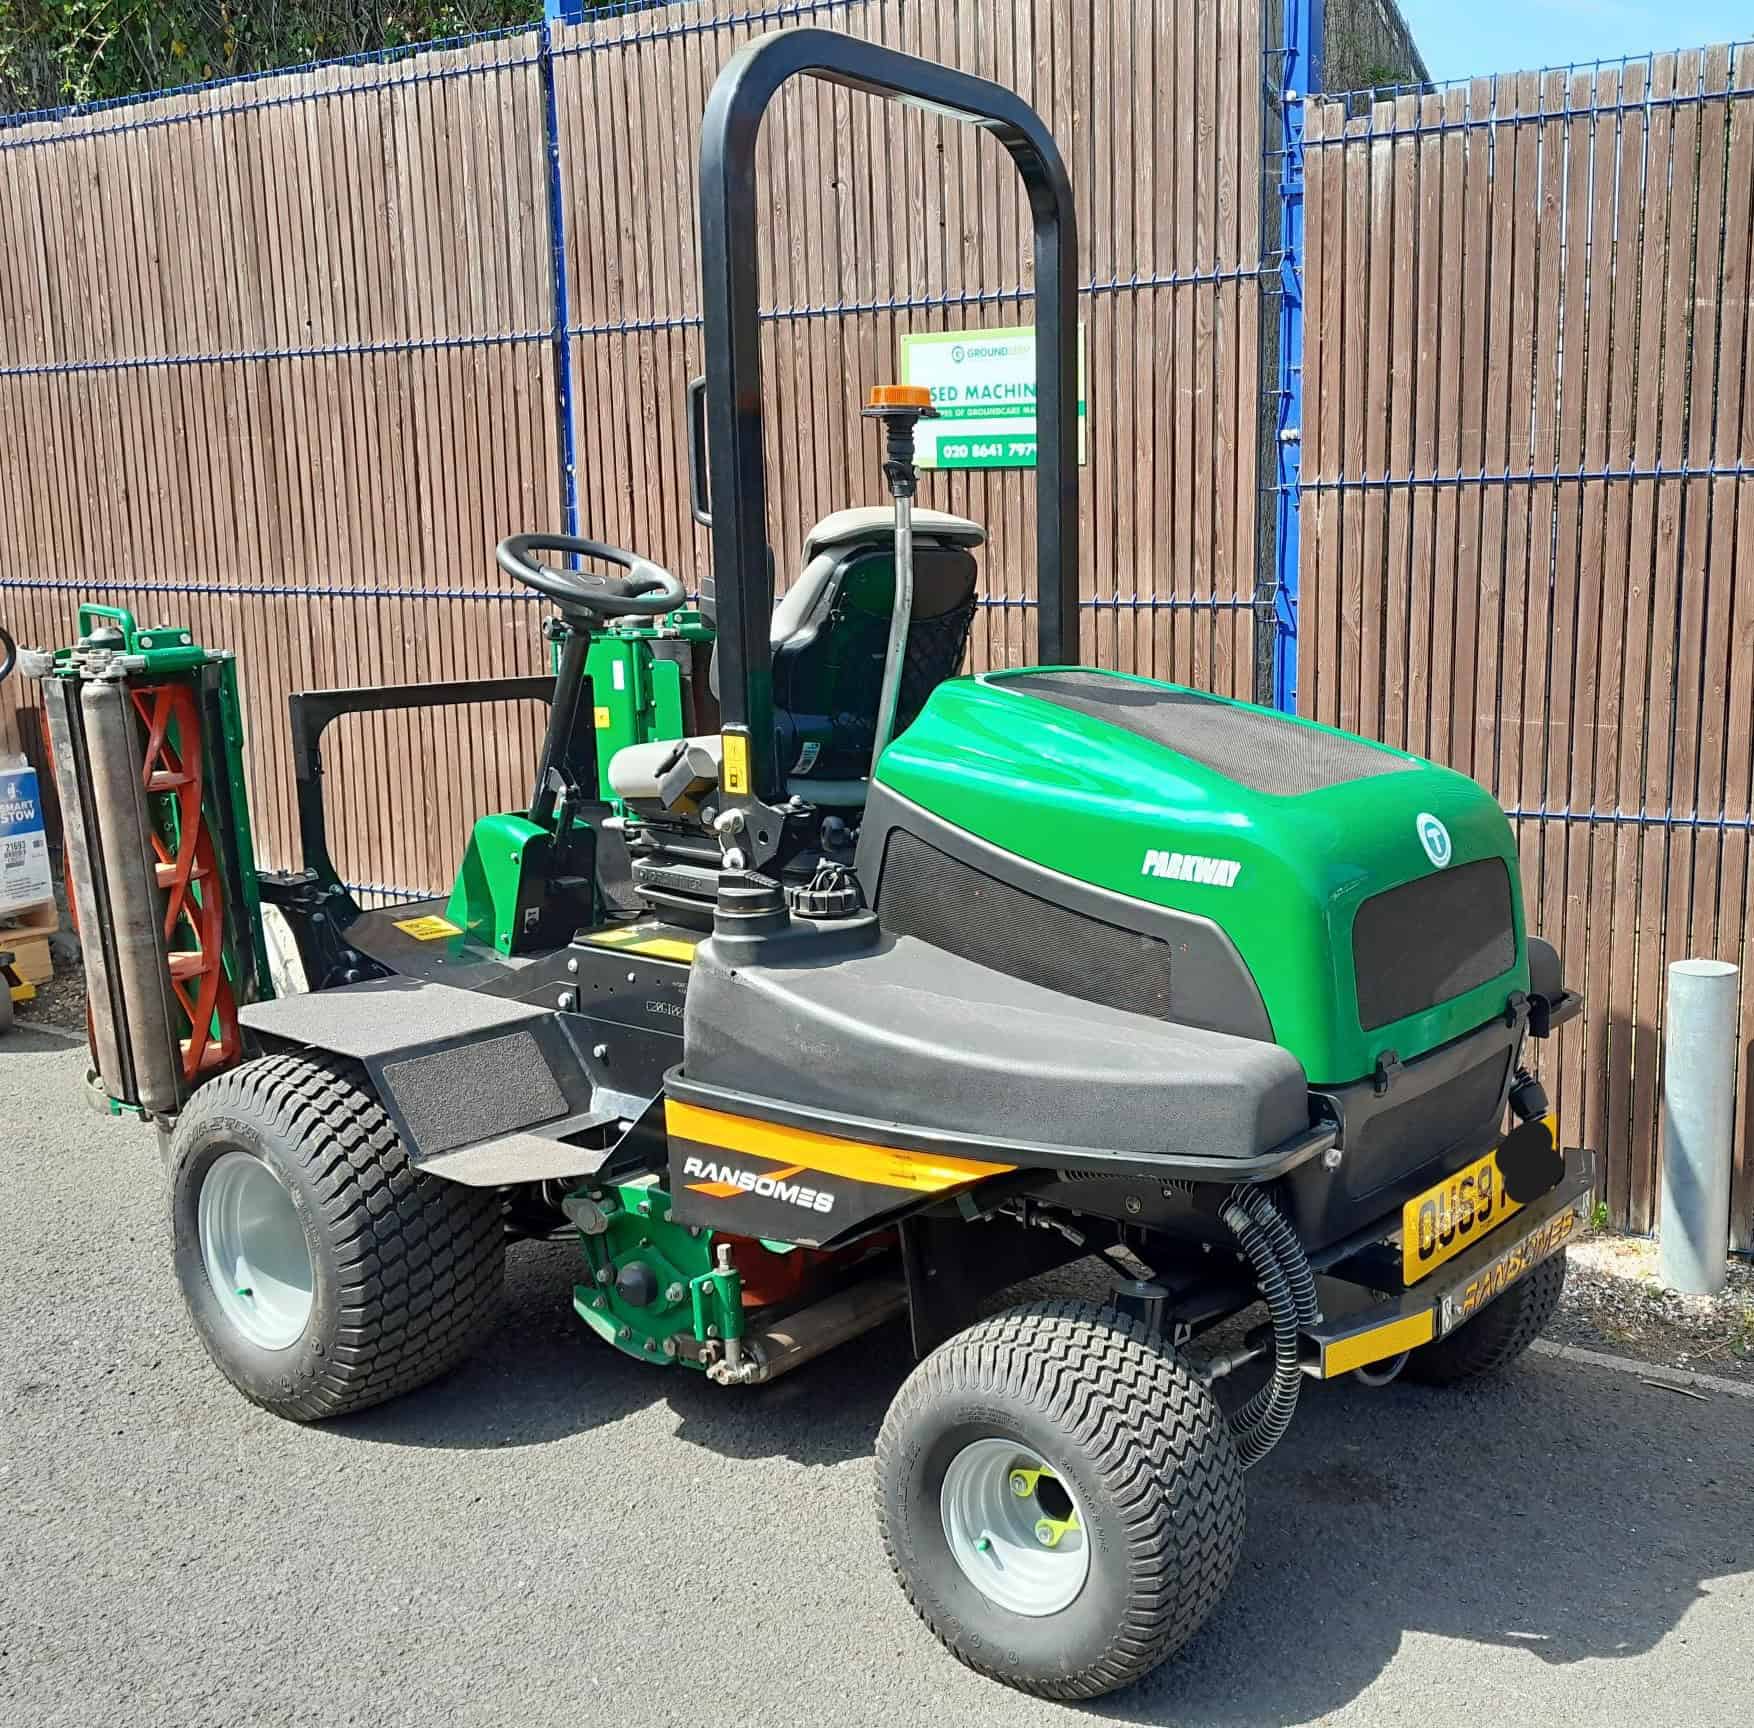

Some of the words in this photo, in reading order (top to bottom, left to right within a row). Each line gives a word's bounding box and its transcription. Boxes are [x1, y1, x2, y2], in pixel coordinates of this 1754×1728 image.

[930, 386, 958, 402] SED
[966, 383, 1036, 400] MACHIN
[943, 444, 968, 459] 020
[971, 443, 1003, 458] 8641
[1007, 442, 1036, 457] 797
[0, 808, 35, 824] STOW
[1141, 849, 1242, 888] PARKWAY
[683, 1156, 835, 1213] RANSOMES
[1463, 1208, 1577, 1314] RANSOMES
